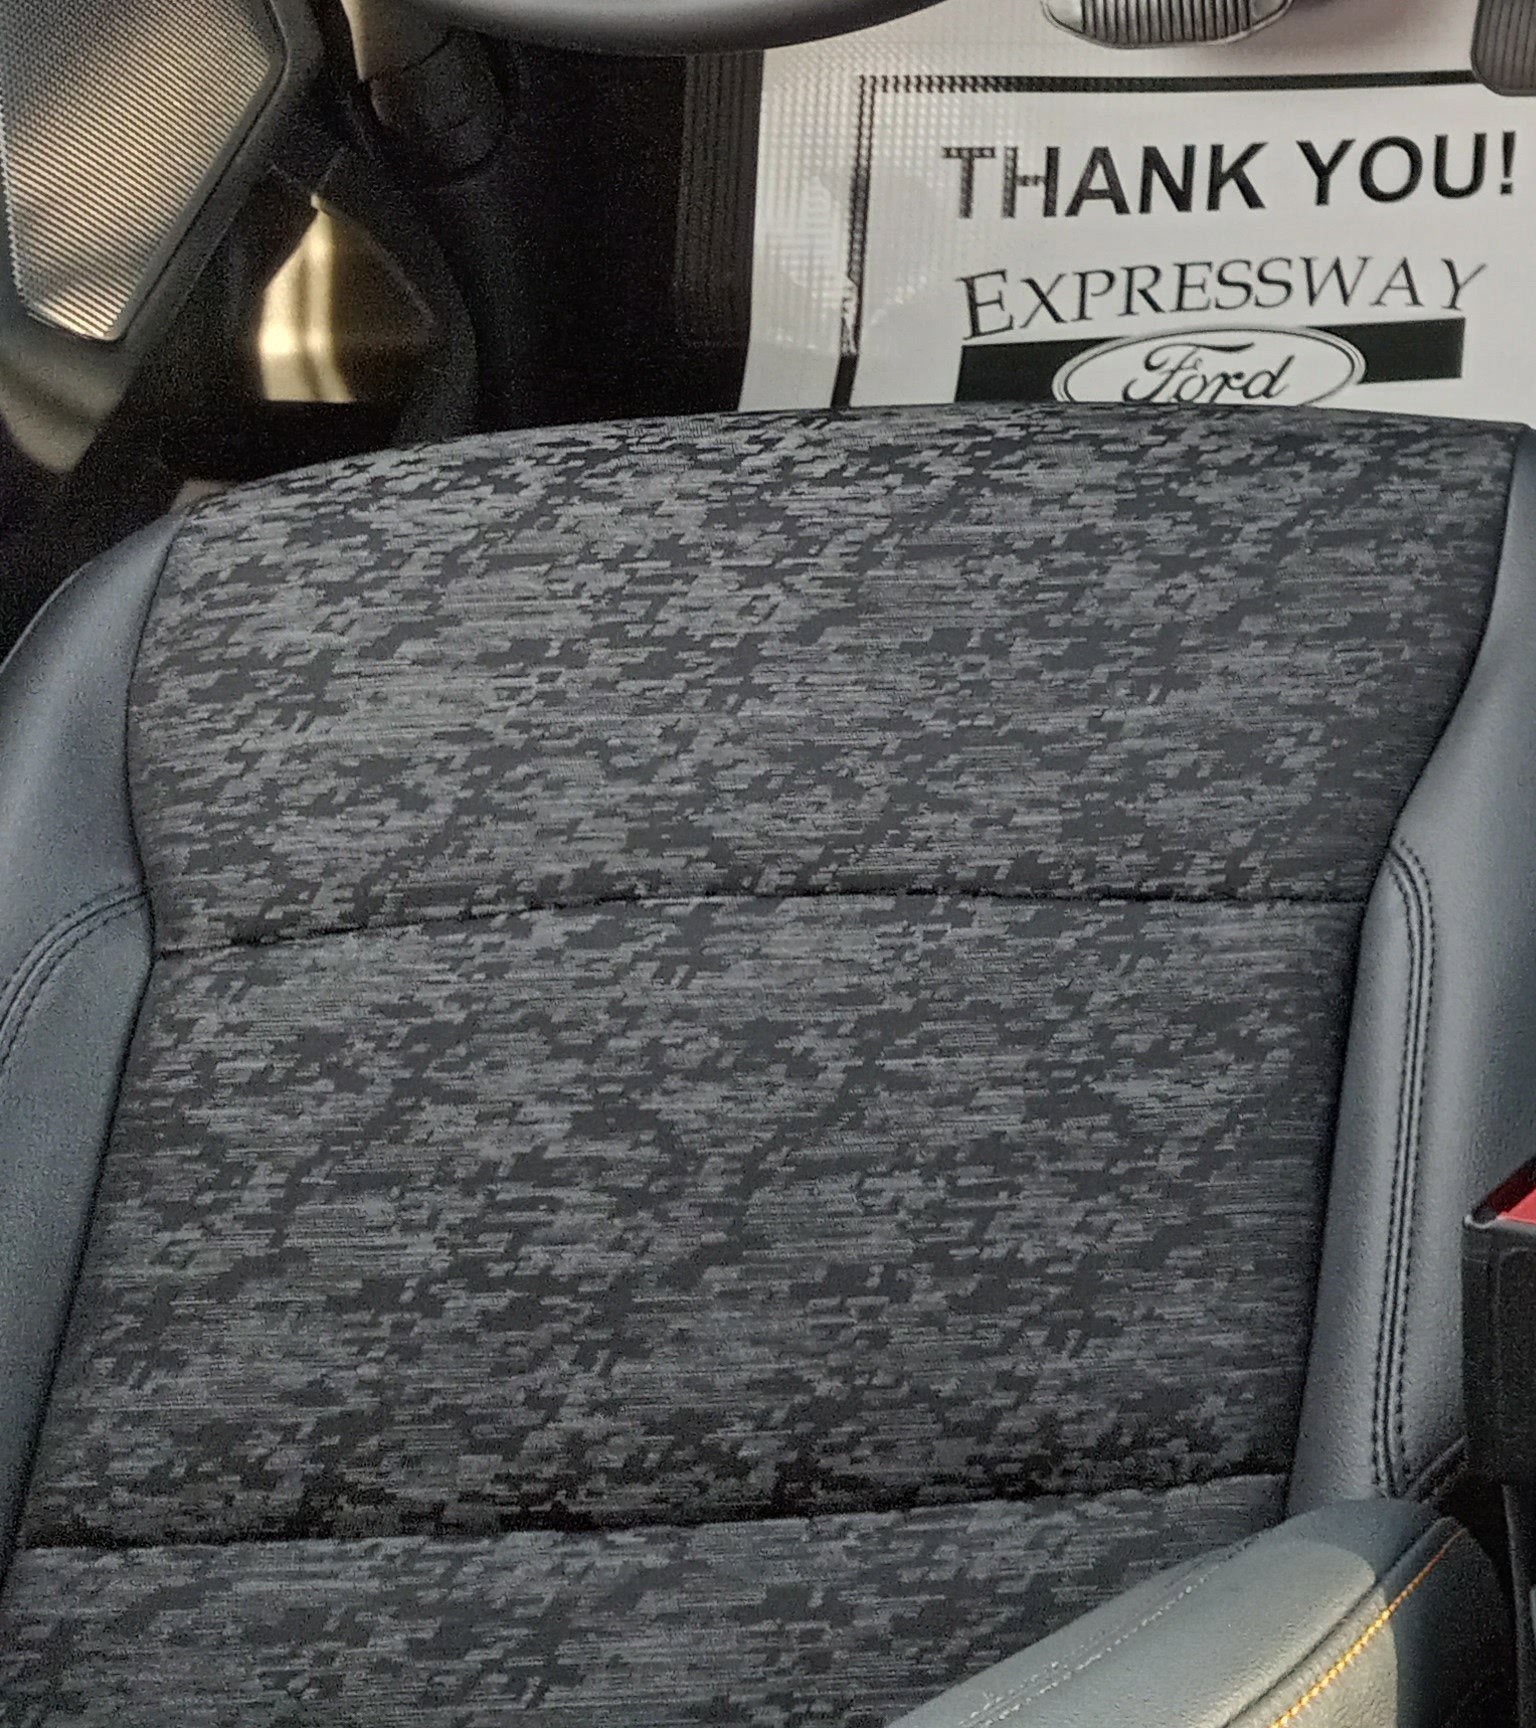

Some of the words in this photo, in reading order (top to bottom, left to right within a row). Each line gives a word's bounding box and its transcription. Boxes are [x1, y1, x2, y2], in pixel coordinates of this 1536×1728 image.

[942, 142, 1269, 219] THANK
[1297, 130, 1517, 207] YOU!
[955, 256, 1487, 340] EXPRESSWAY
[1122, 341, 1296, 403] Ford
